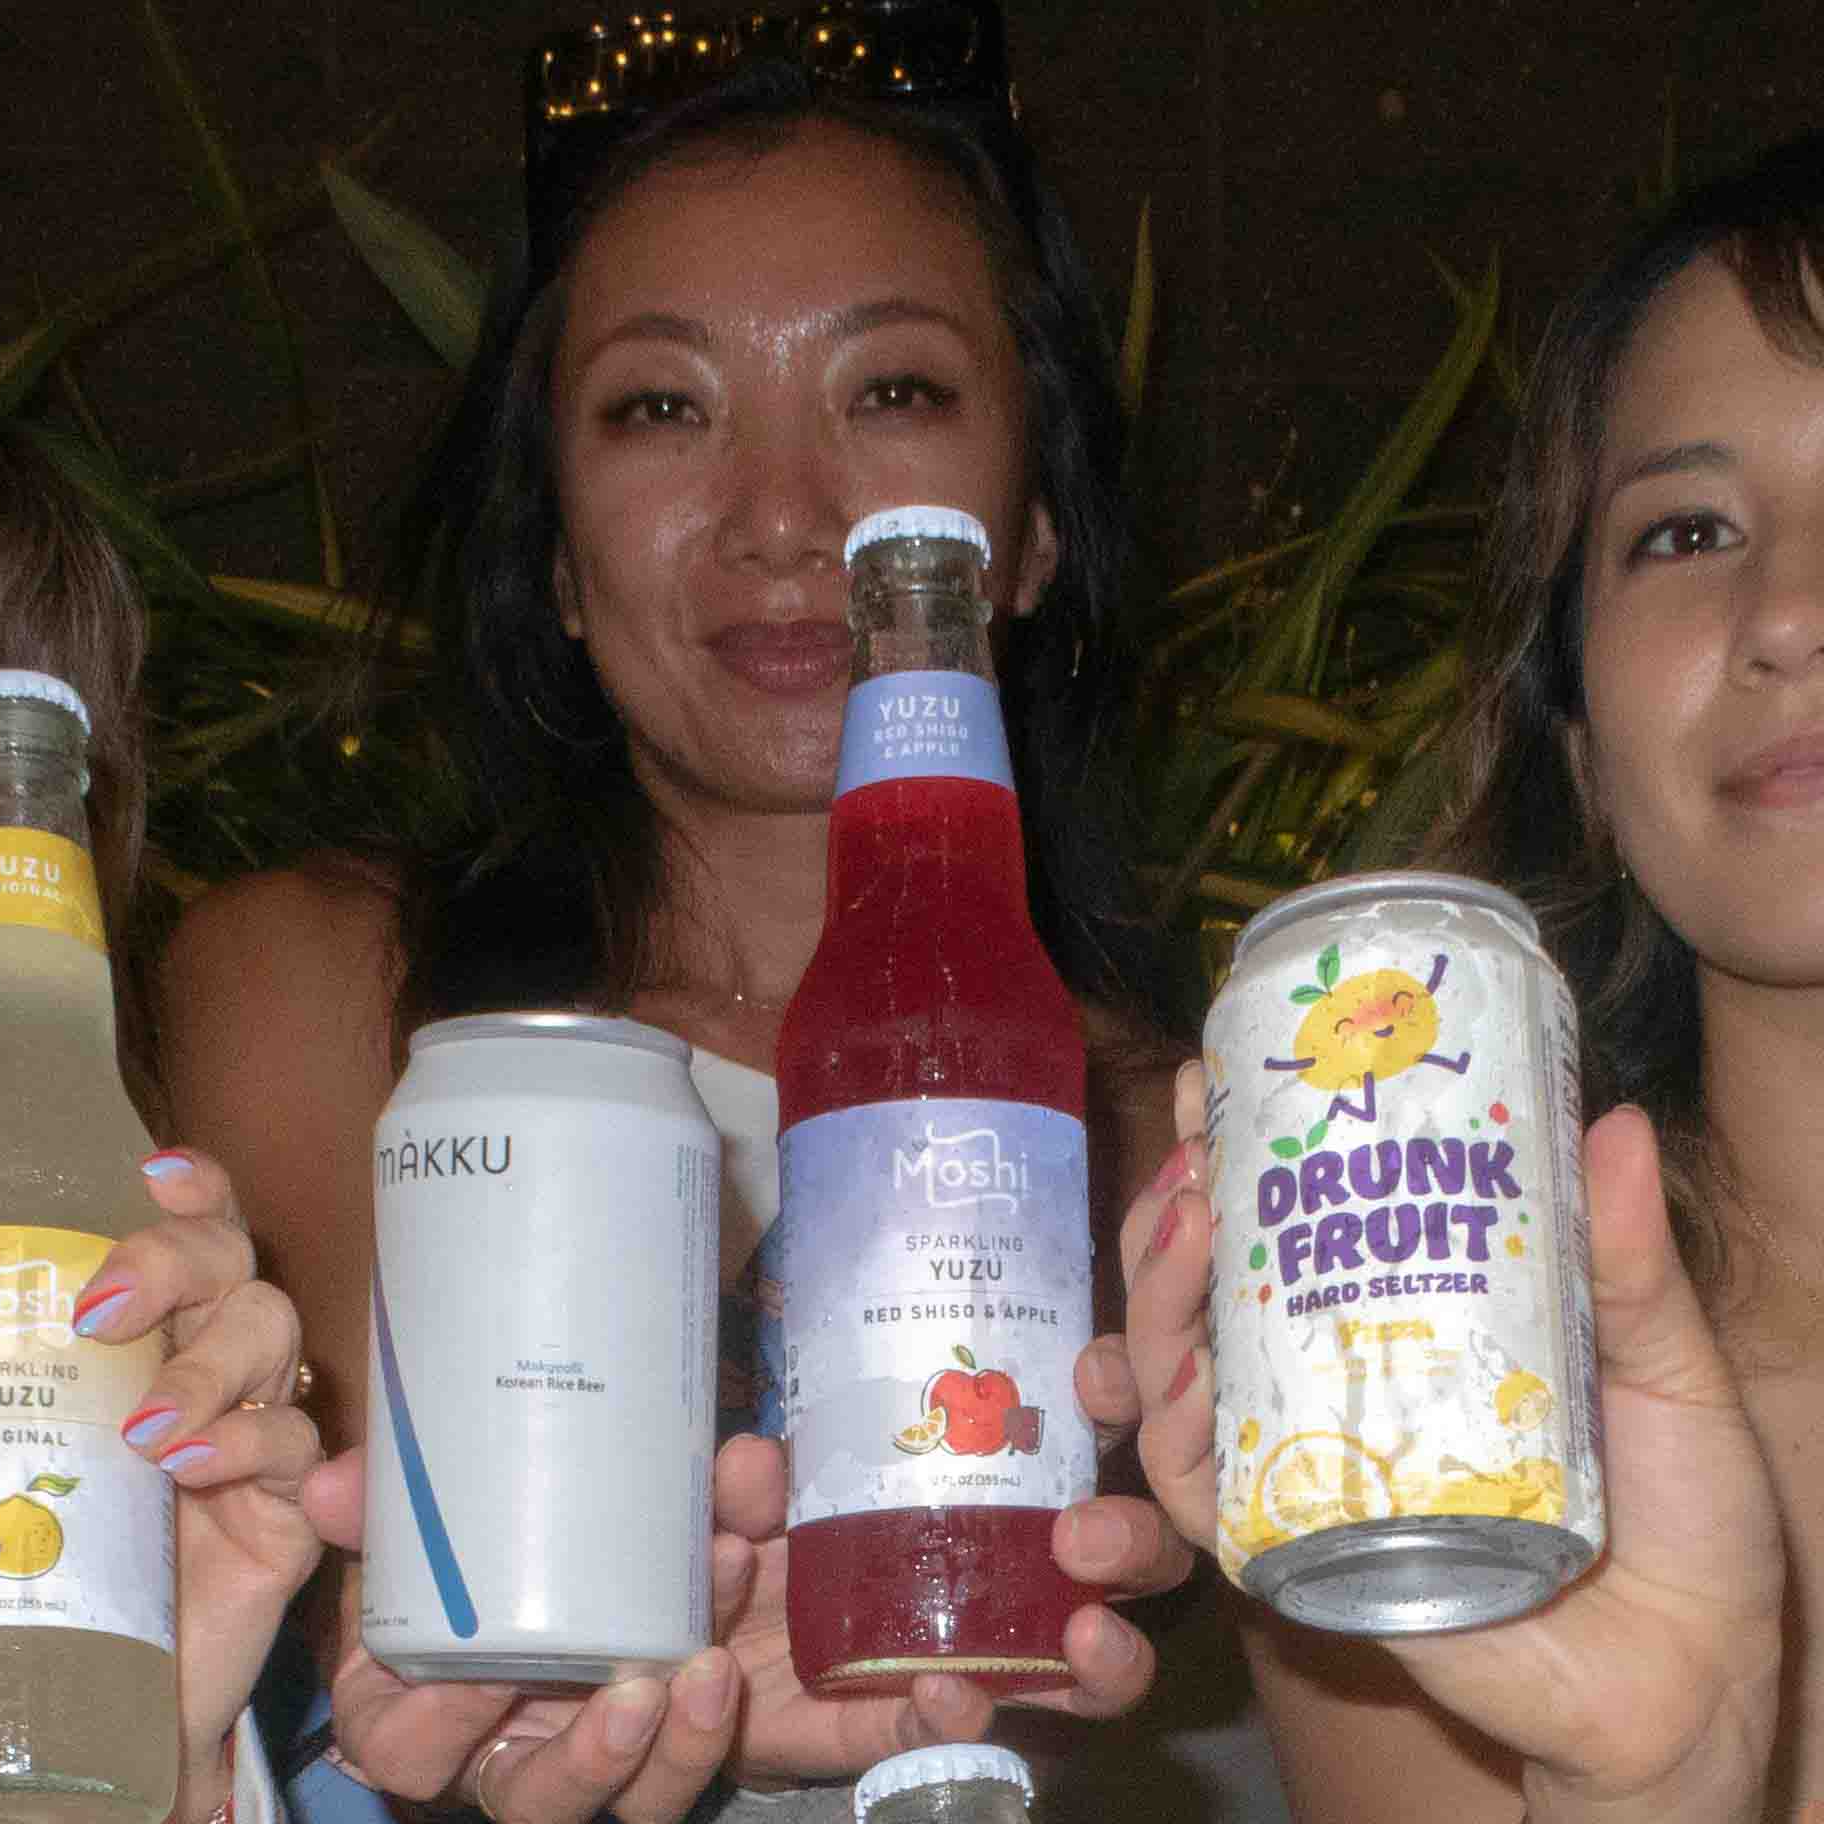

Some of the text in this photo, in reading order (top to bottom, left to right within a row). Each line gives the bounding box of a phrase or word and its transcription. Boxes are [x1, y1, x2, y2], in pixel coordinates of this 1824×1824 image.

[878, 696, 960, 720] YUZU
[891, 1121, 1029, 1215] Moshi
[1257, 1137, 1523, 1229] DRUNK
[905, 1233, 1025, 1252] SPARKLING
[1277, 1201, 1499, 1288] FRUIT
[929, 1258, 1004, 1281] YUZU
[1286, 1273, 1490, 1318] HARD SELTZER
[863, 1302, 1059, 1326] RED SHISO & APPLE
